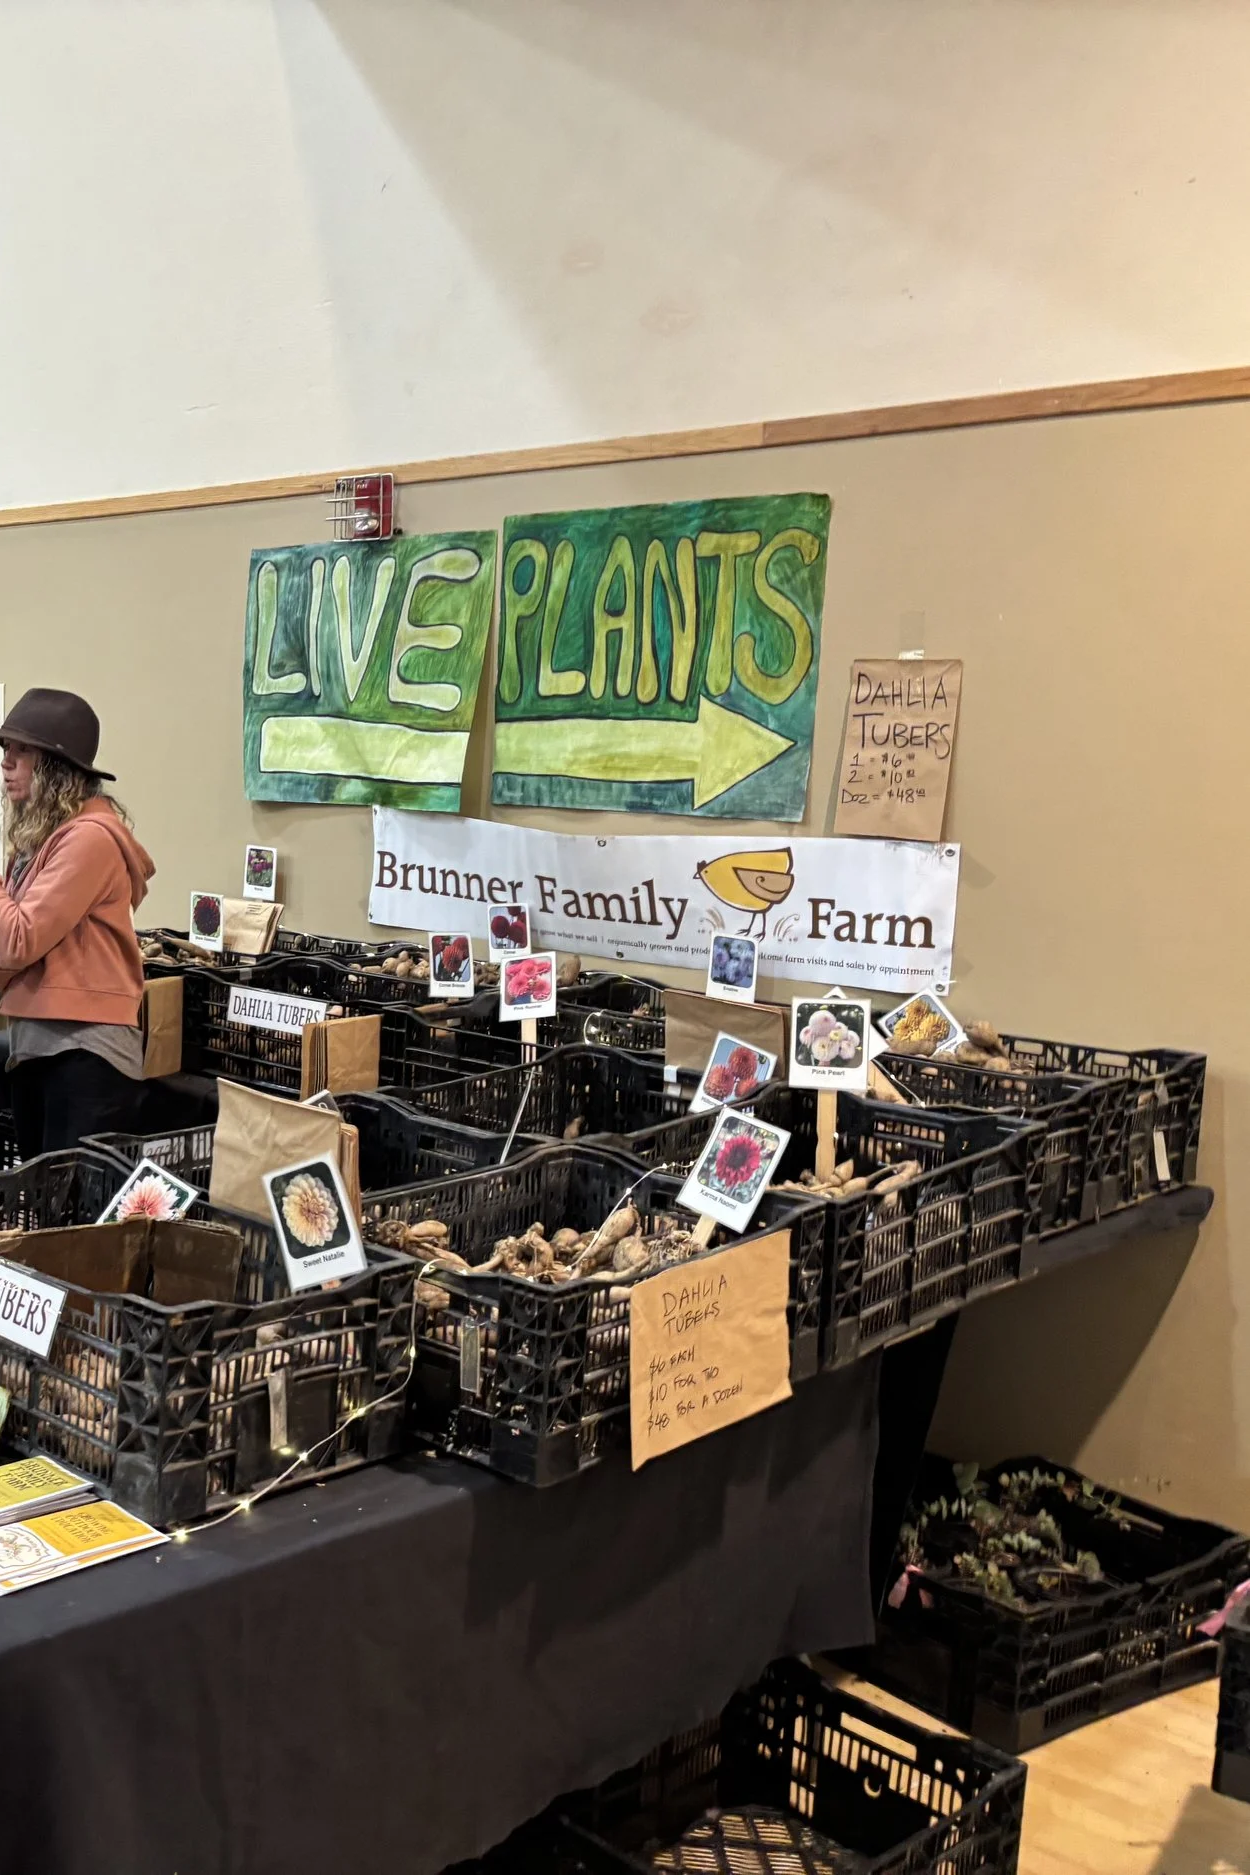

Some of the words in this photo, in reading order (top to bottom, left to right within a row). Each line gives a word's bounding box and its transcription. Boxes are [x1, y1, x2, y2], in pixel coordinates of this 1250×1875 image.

[252, 548, 483, 712] LIVE
[499, 527, 821, 705] PLANTS
[854, 671, 948, 709] DAHLIA
[853, 713, 950, 760] TUBERS
[848, 770, 862, 783] 2
[375, 850, 523, 904] Brunner
[534, 874, 689, 940] Family
[807, 897, 936, 949] Farm
[557, 930, 574, 940] what
[607, 938, 647, 949] organically
[674, 944, 689, 953] and
[785, 953, 805, 964] farm
[807, 955, 828, 966] visits
[829, 959, 844, 968] and
[846, 960, 865, 970] sales
[866, 962, 877, 974] by
[879, 963, 935, 977] appointment
[233, 995, 273, 1021] DAHLIA
[277, 1003, 320, 1026] TUBERS
[302, 1258, 323, 1269] Sweet
[323, 1251, 345, 1263] Natalie
[661, 1274, 728, 1317] DAHLIA
[662, 1301, 722, 1337] TUBERS
[649, 1356, 666, 1382] $6
[670, 1345, 696, 1368] EACH
[648, 1413, 670, 1437] $48
[676, 1403, 696, 1417] FOR
[702, 1395, 709, 1409] A
[712, 1376, 744, 1404] DOZEN
[649, 1383, 668, 1410] $10
[673, 1375, 697, 1391] FOR
